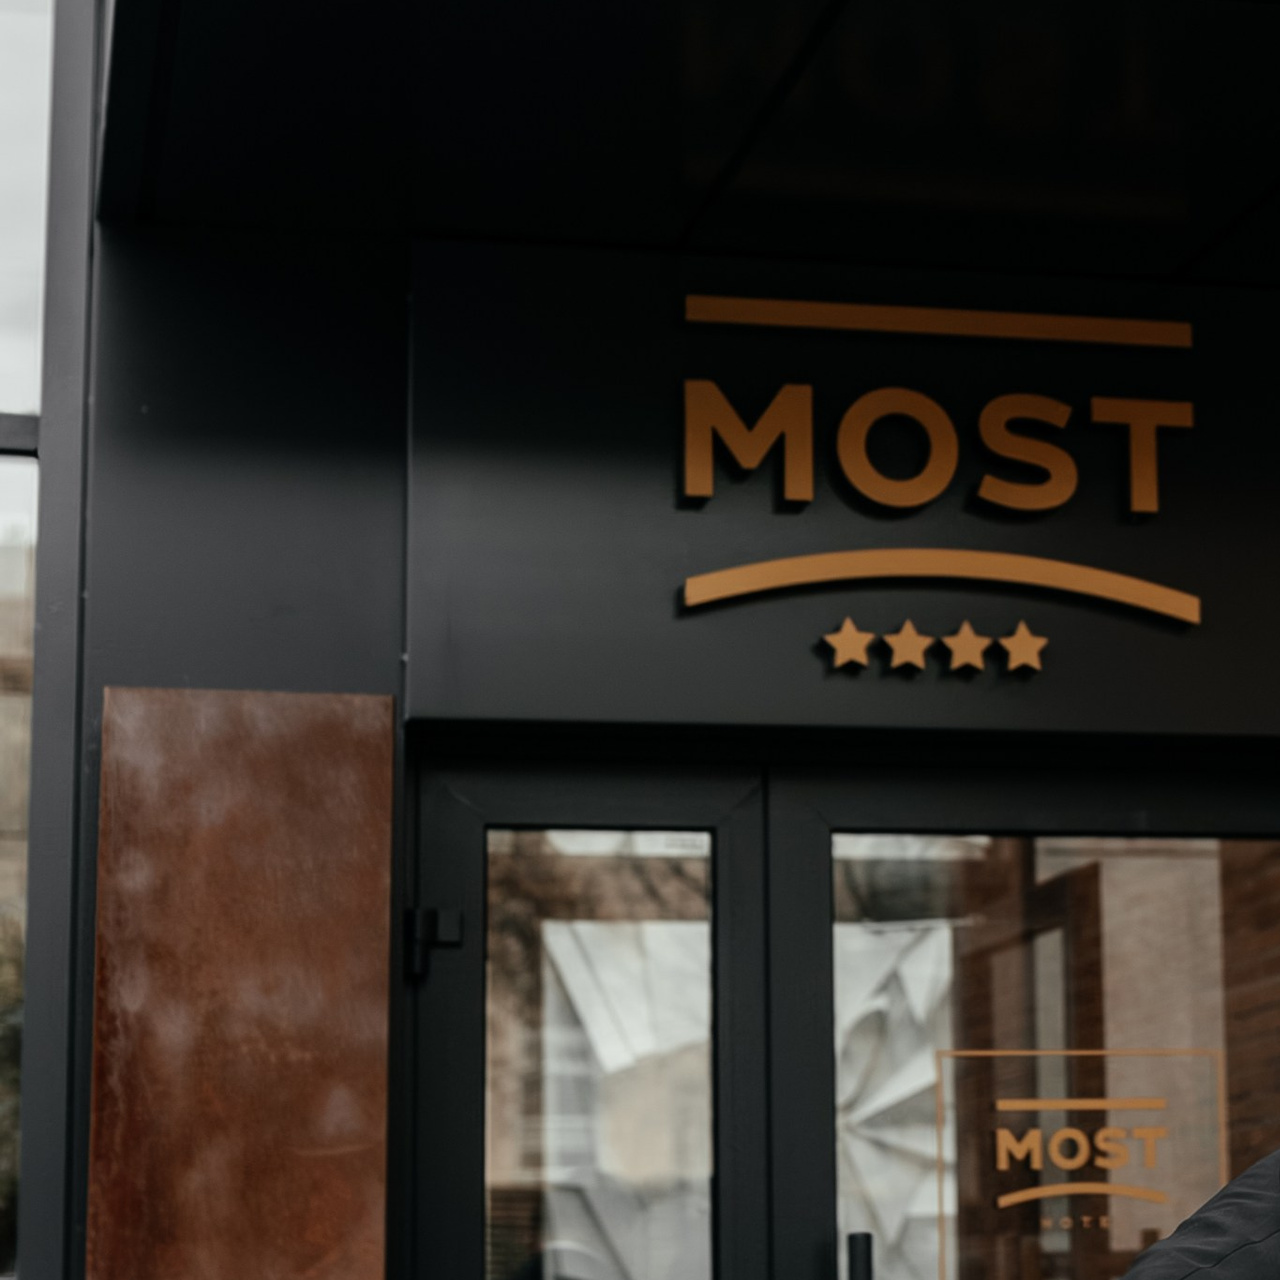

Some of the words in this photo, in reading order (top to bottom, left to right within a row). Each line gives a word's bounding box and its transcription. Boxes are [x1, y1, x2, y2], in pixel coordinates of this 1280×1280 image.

[683, 379, 1194, 514] MOST
[996, 1126, 1168, 1170] MOST
[1041, 1216, 1120, 1229] HOTE
